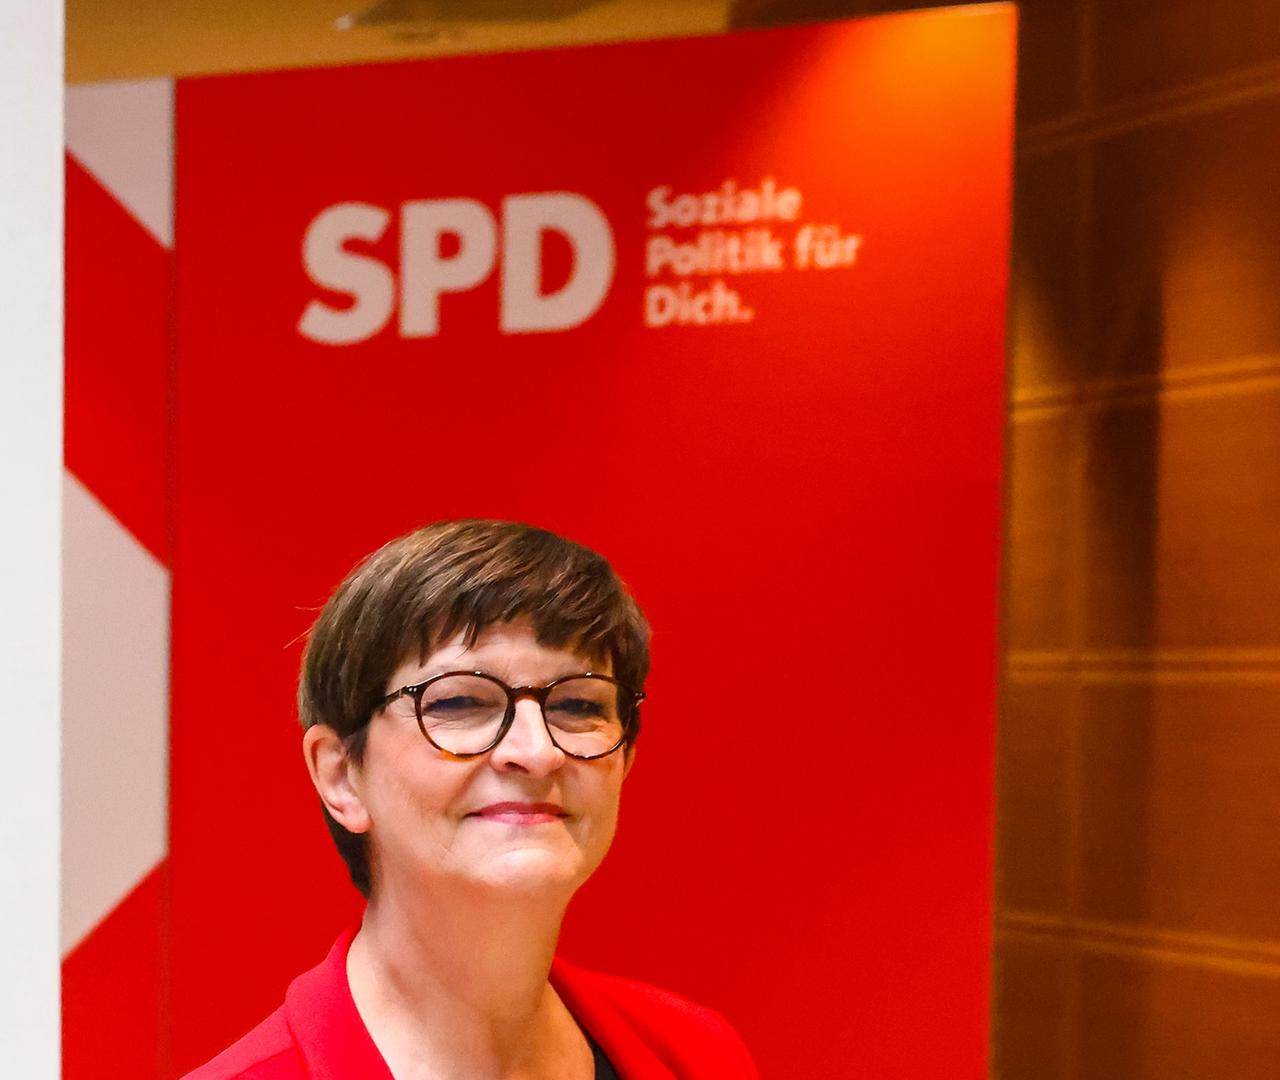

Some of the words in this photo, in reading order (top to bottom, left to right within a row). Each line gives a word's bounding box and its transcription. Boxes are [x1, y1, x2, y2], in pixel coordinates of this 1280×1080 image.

[647, 177, 801, 229] Soziale
[297, 190, 617, 346] SPD
[646, 228, 784, 277] Politik
[794, 224, 861, 270] für
[645, 278, 754, 328] Dich.
